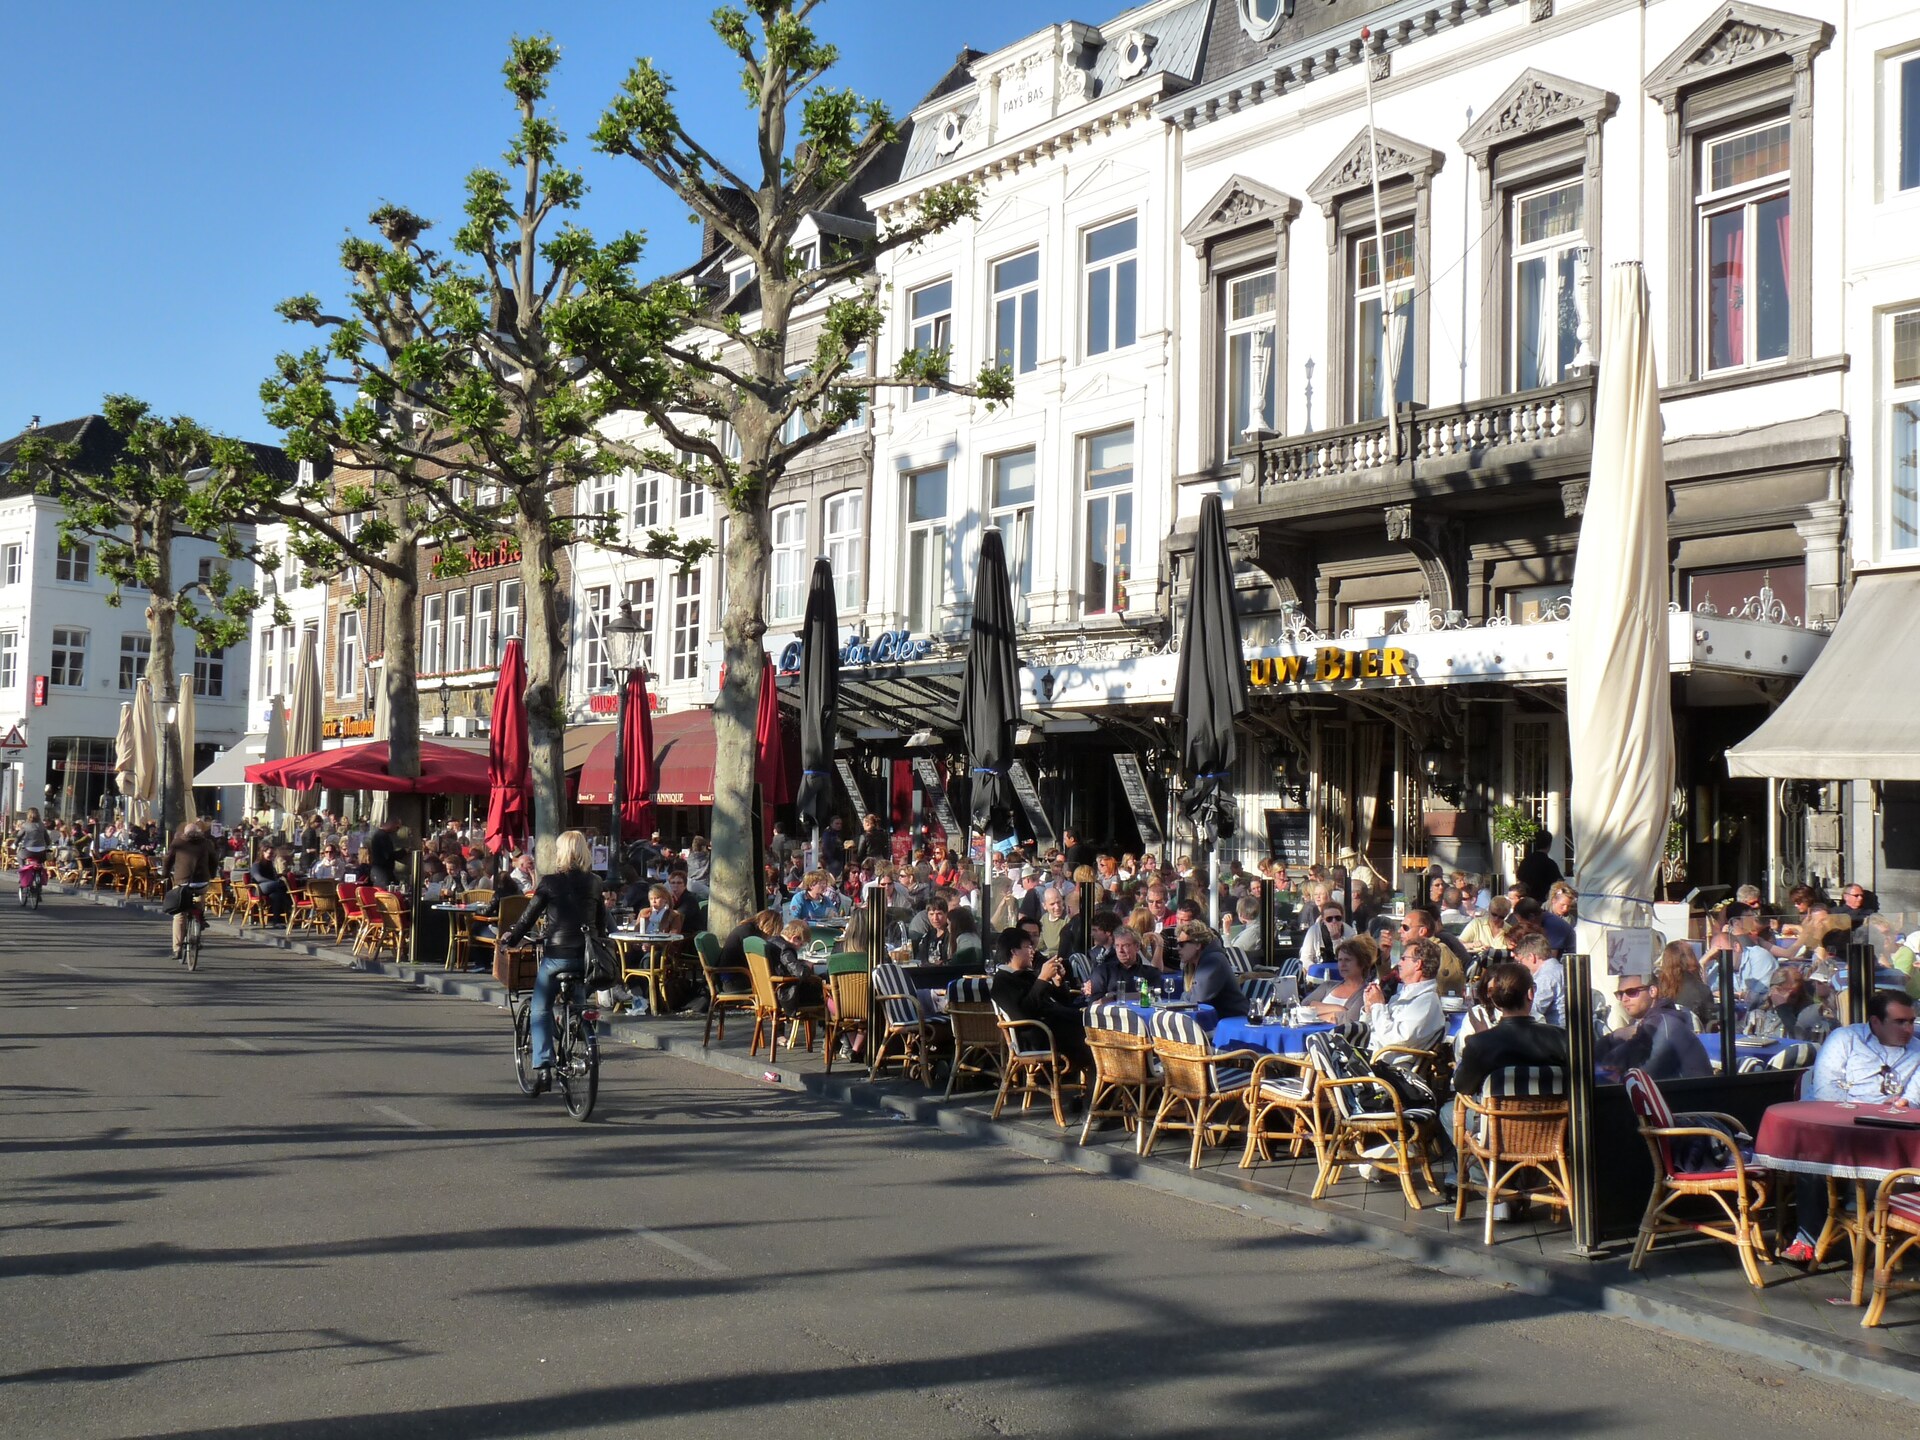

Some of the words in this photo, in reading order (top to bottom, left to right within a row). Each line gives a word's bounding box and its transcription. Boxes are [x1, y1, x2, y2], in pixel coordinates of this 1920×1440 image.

[1003, 95, 1023, 114] PAYS
[1027, 86, 1044, 103] BAS
[871, 630, 932, 663] Bier
